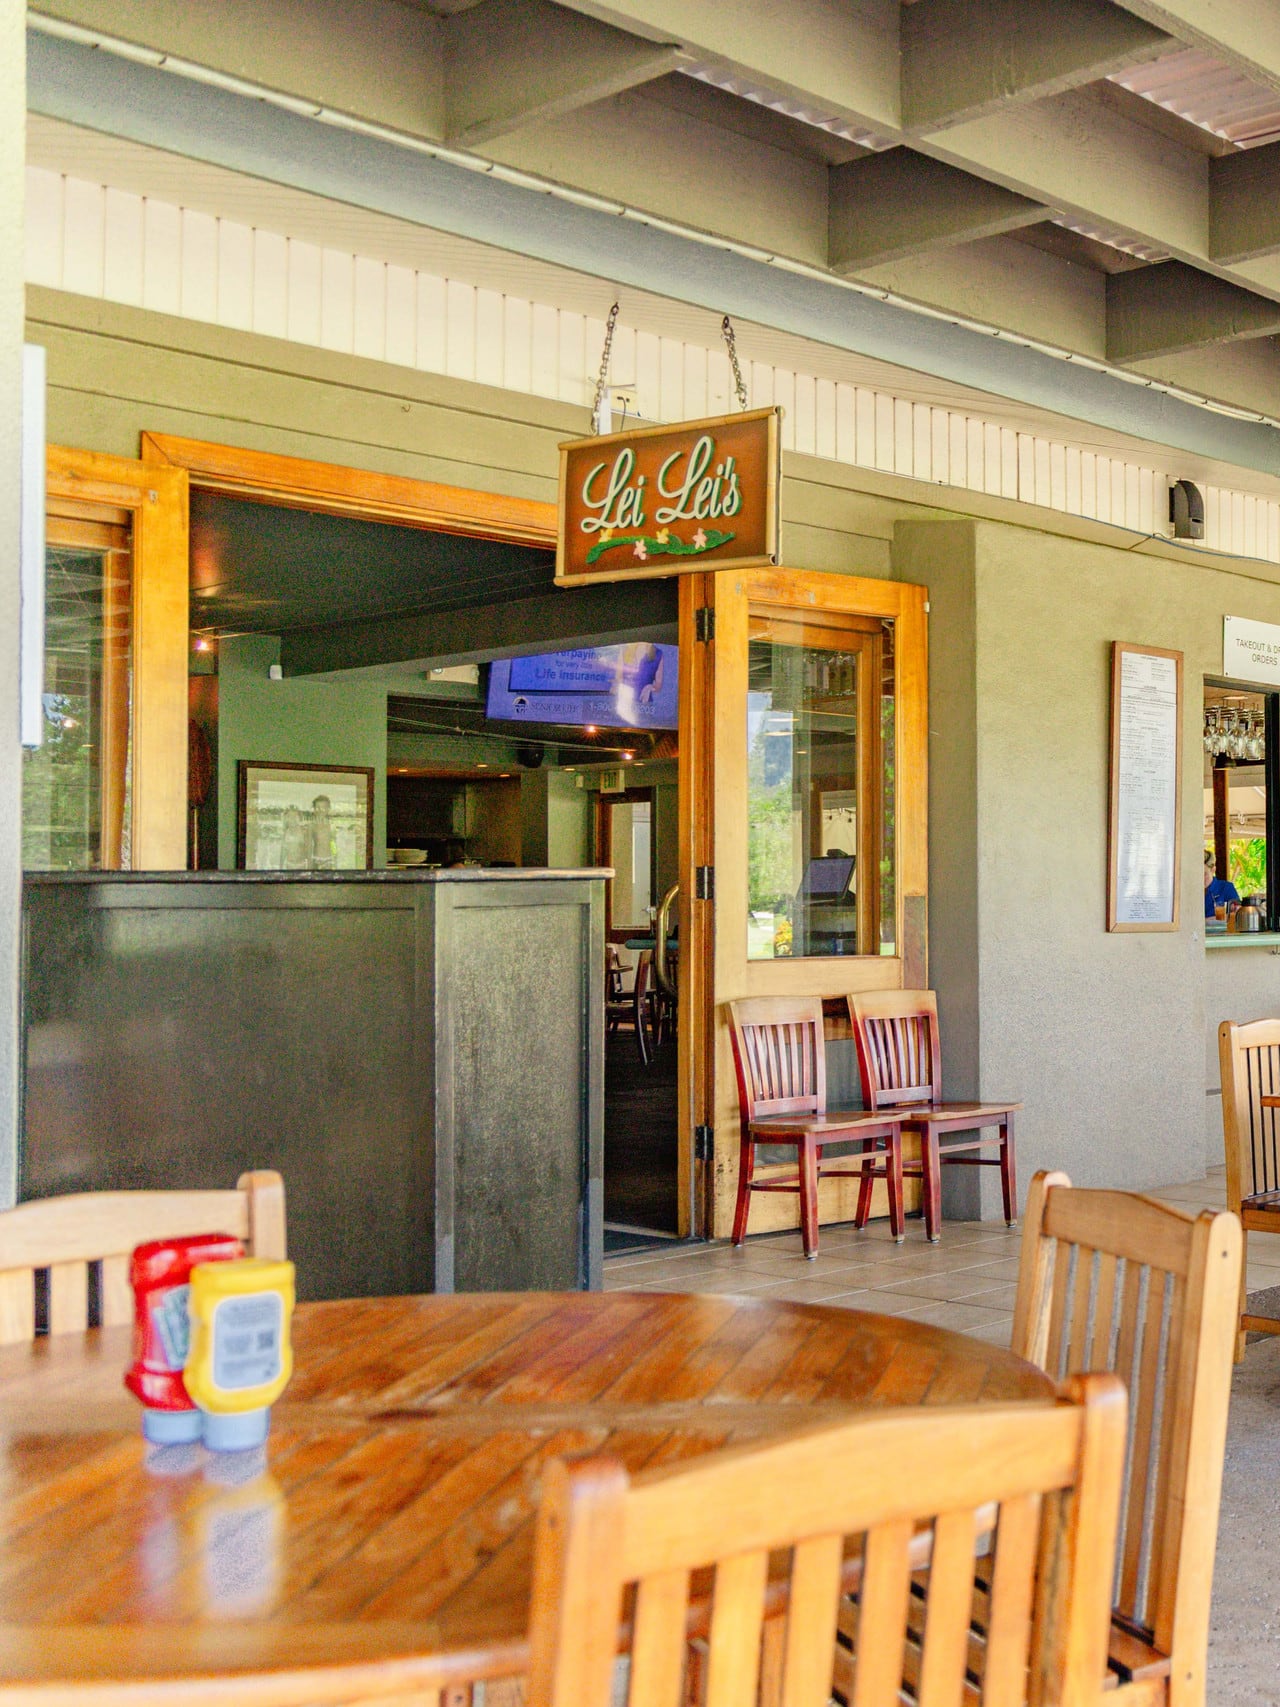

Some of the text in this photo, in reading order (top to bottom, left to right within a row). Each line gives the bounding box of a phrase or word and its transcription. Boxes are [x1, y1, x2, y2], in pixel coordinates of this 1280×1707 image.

[581, 436, 742, 533] Lei Lei's
[1235, 638, 1265, 651] TAKEOUT
[1267, 643, 1272, 653] &
[1251, 653, 1278, 666] ORDERS
[534, 668, 556, 680] Life
